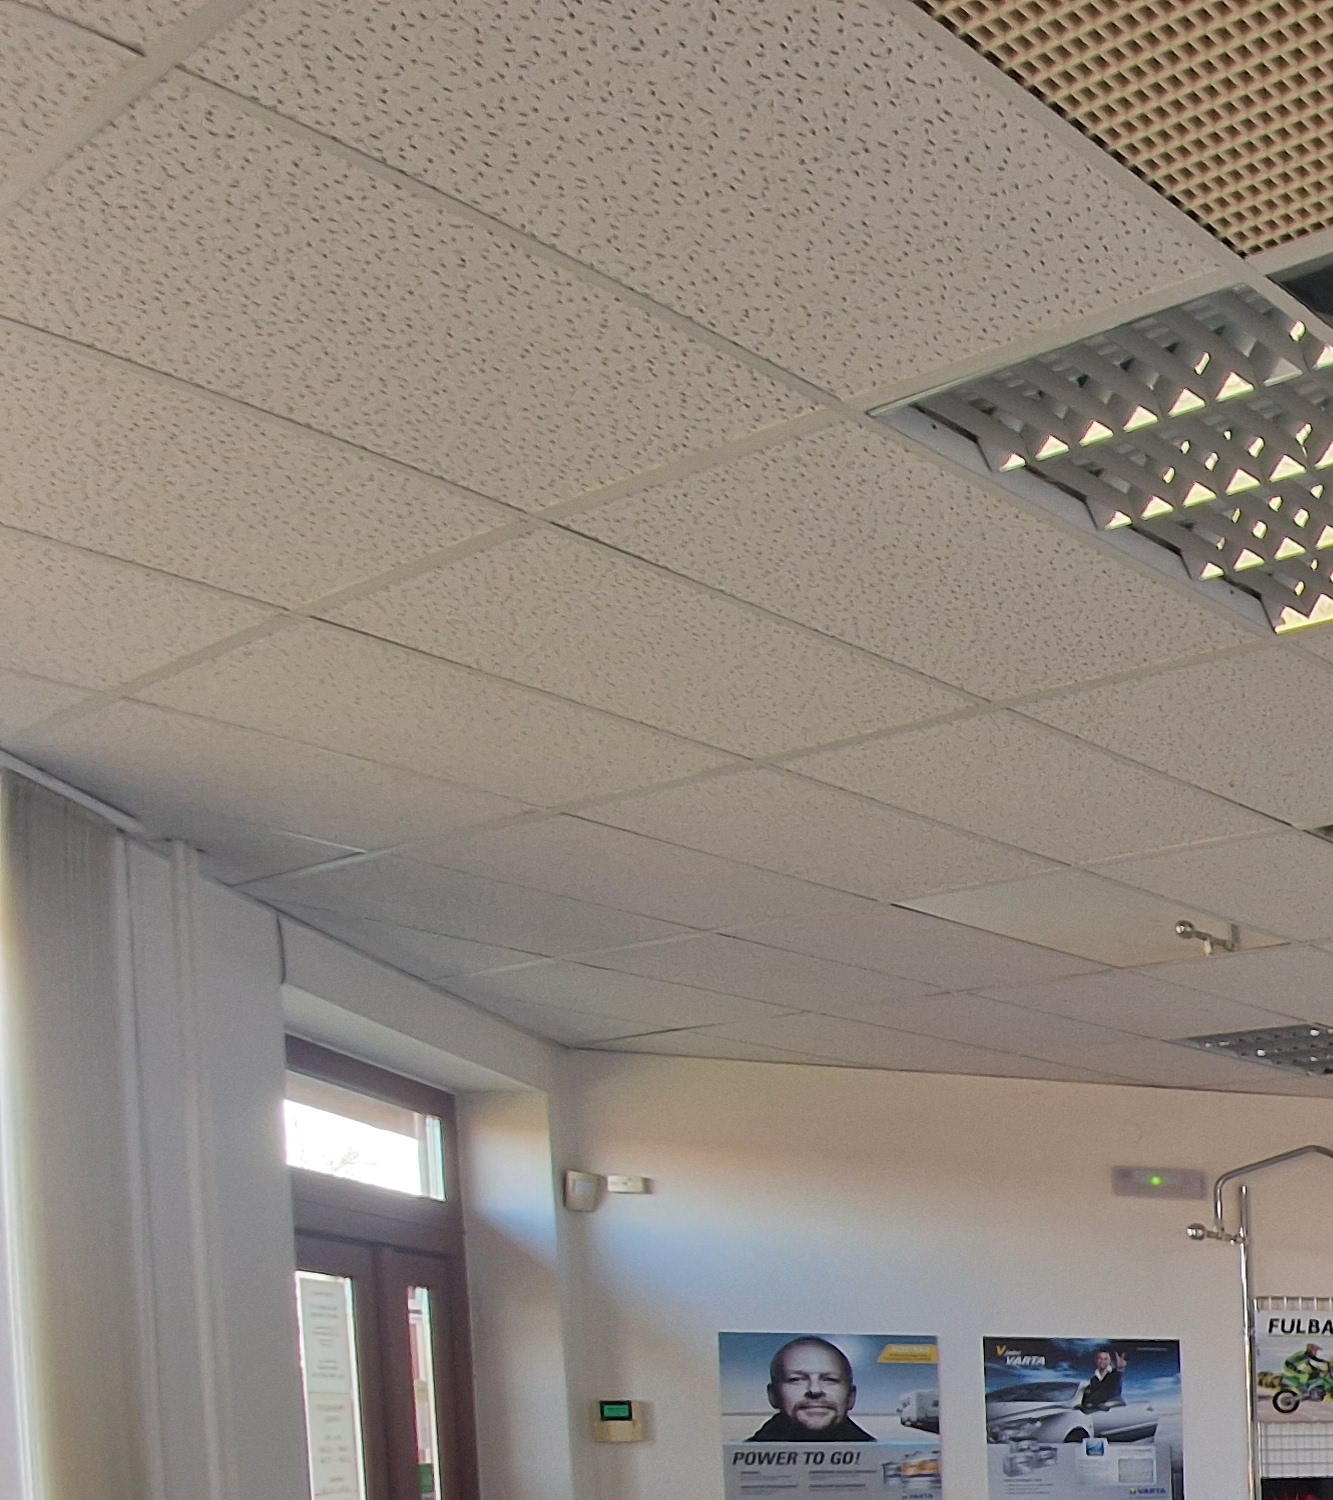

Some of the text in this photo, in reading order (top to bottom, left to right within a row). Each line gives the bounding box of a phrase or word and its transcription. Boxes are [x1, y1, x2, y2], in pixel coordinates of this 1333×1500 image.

[1006, 1355, 1047, 1367] VARTA
[731, 1451, 861, 1466] POWER TO GO!
[1137, 1487, 1167, 1495] VARTA
